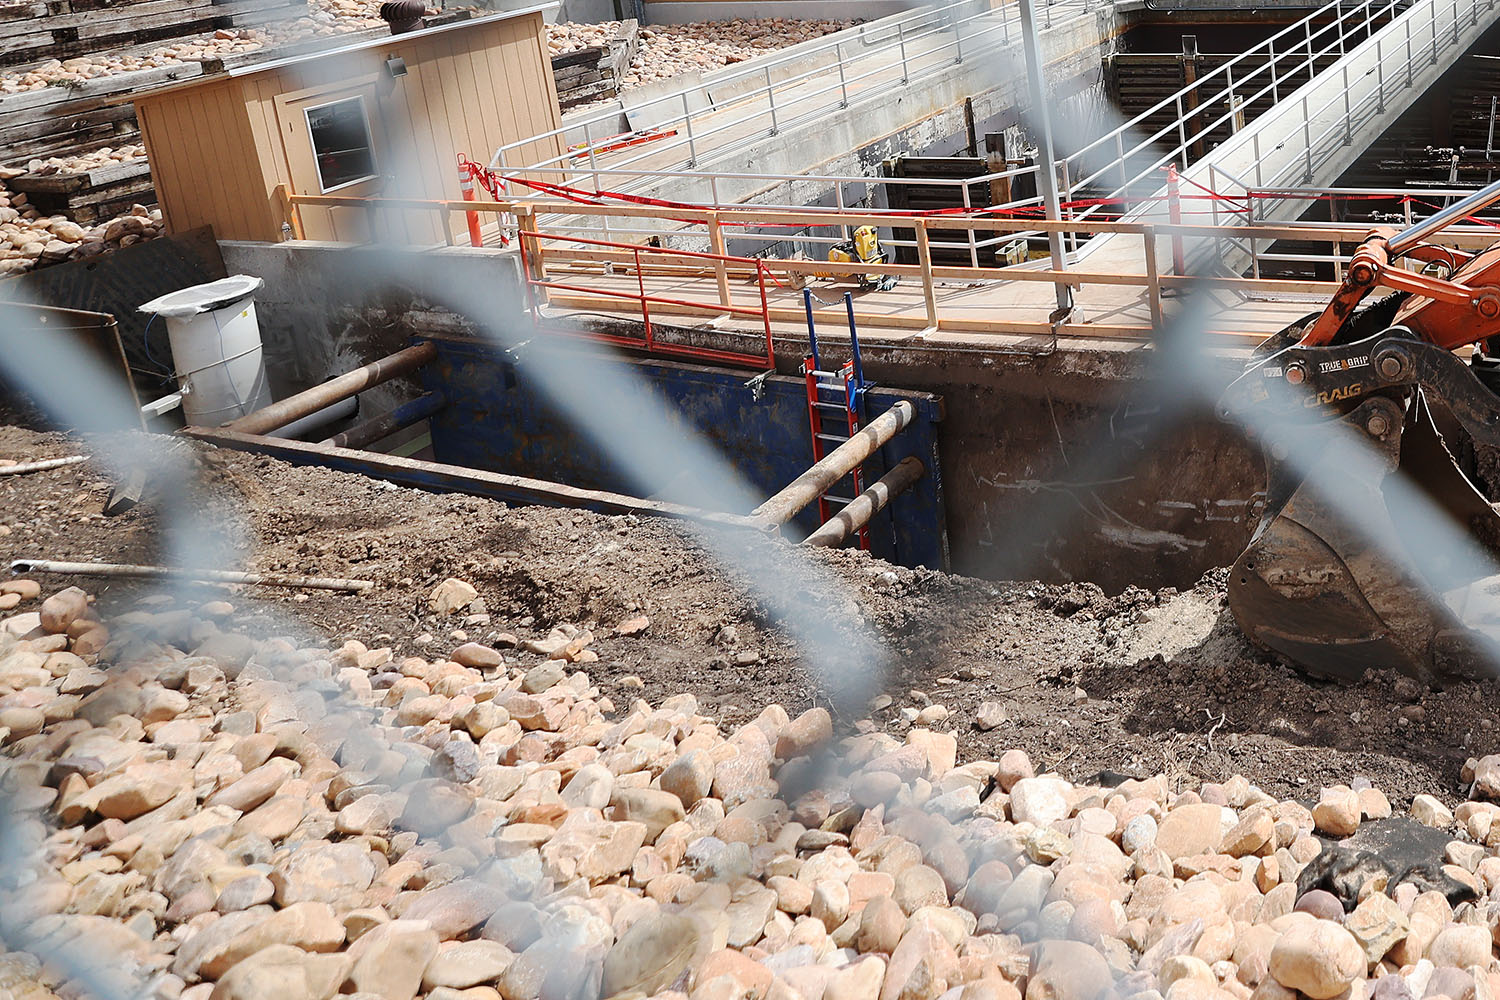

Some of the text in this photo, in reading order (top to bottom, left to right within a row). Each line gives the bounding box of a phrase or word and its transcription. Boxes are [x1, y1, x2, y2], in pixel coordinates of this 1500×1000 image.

[1319, 355, 1369, 371] TRUE GRIP
[1304, 383, 1361, 408] CRAIG
